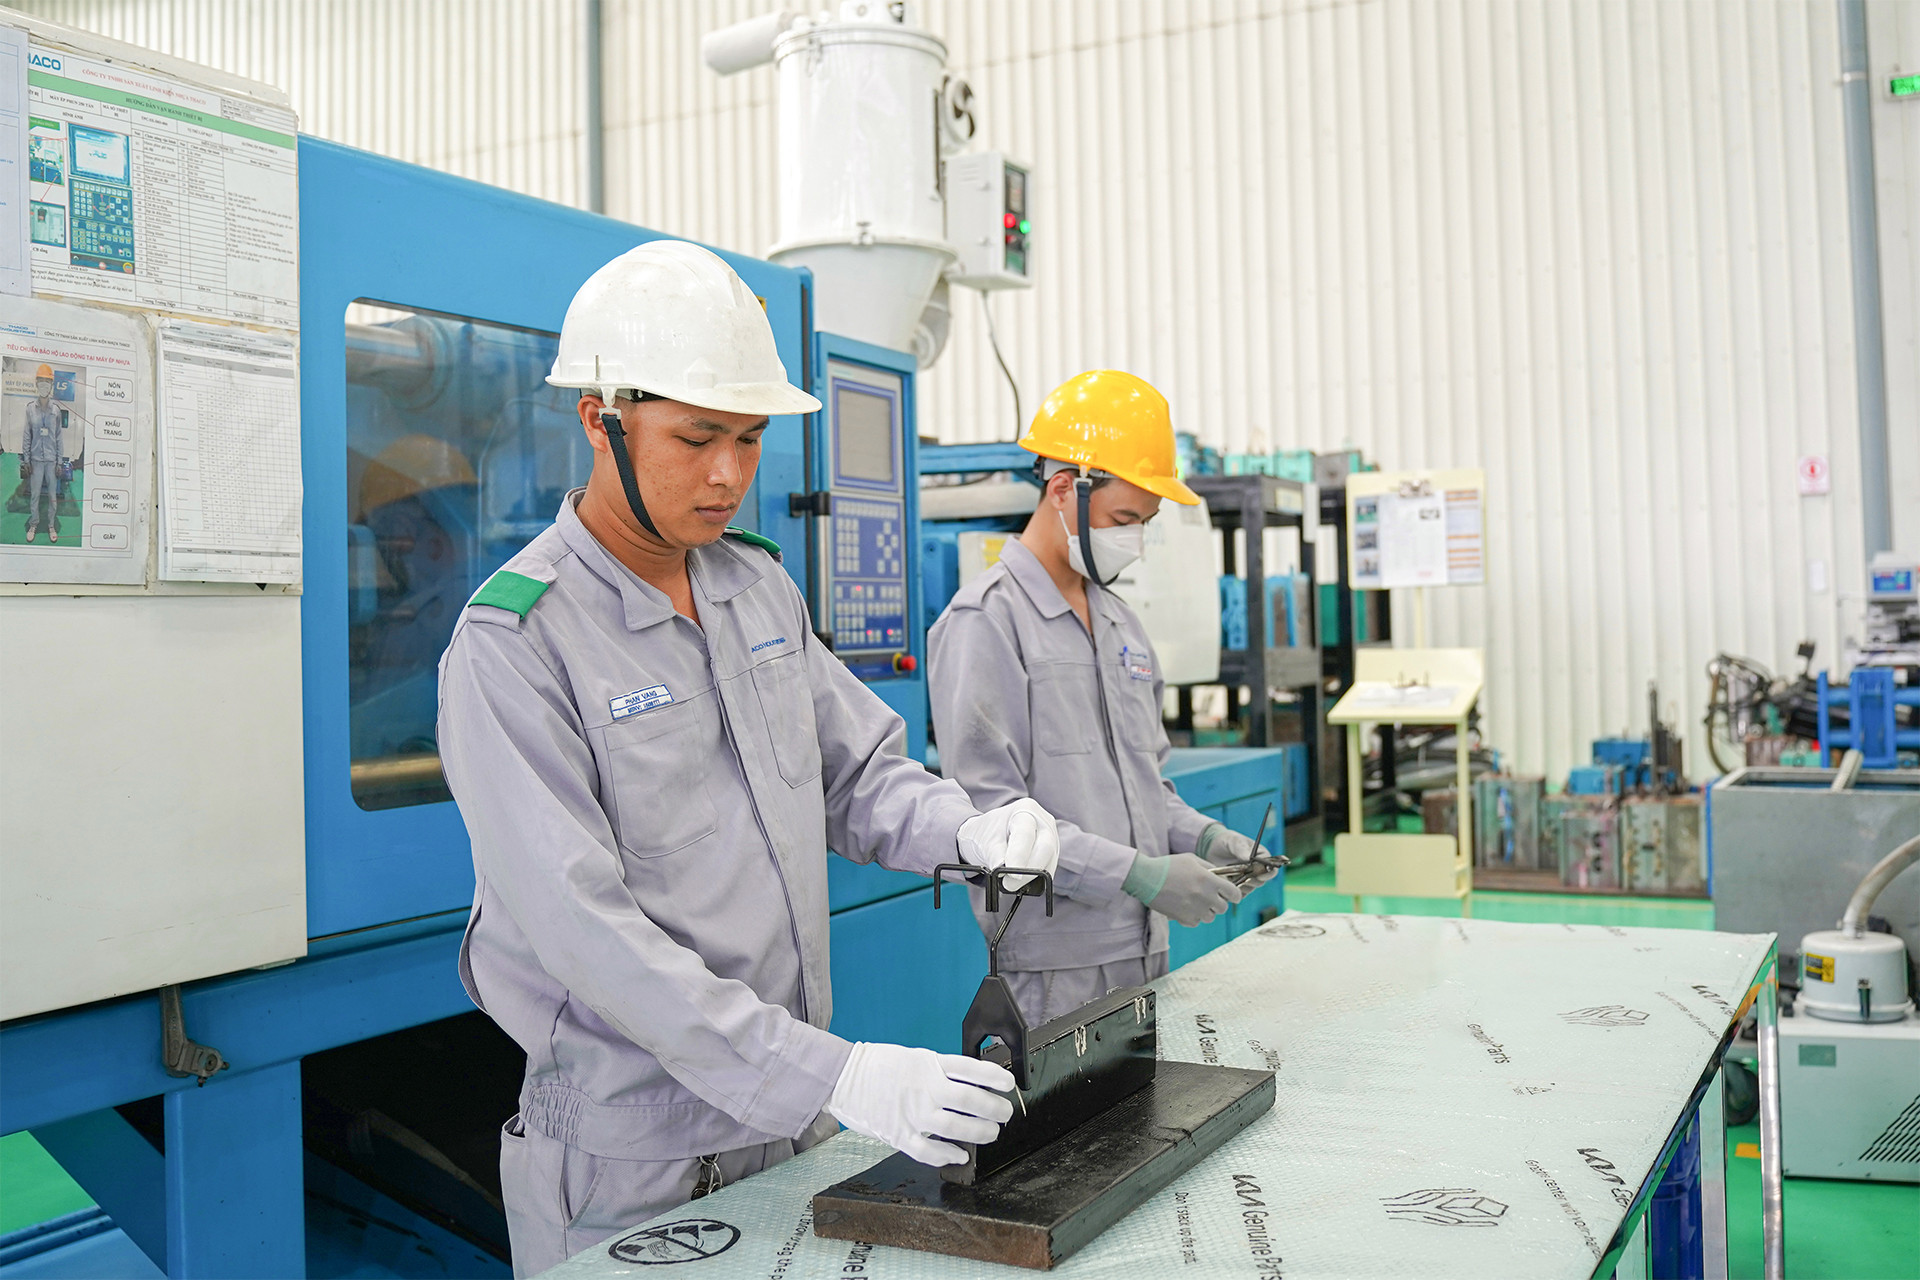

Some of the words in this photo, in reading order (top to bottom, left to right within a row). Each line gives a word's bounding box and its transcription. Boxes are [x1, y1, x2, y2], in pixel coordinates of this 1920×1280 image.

[6, 343, 19, 351] TIÊU
[20, 345, 38, 354] CHUẨN
[70, 352, 85, 361] ĐỘNG
[116, 358, 131, 366] NHỰA
[56, 381, 68, 390] LS
[116, 391, 125, 399] HỘ
[105, 420, 120, 428] KHẨU
[102, 491, 119, 501] ĐỒNG
[103, 502, 118, 510] PHỤC
[103, 532, 116, 540] GIÀY
[1242, 1210, 1276, 1256] Genuine
[774, 1259, 792, 1273] the
[1254, 1257, 1286, 1280] Parts
